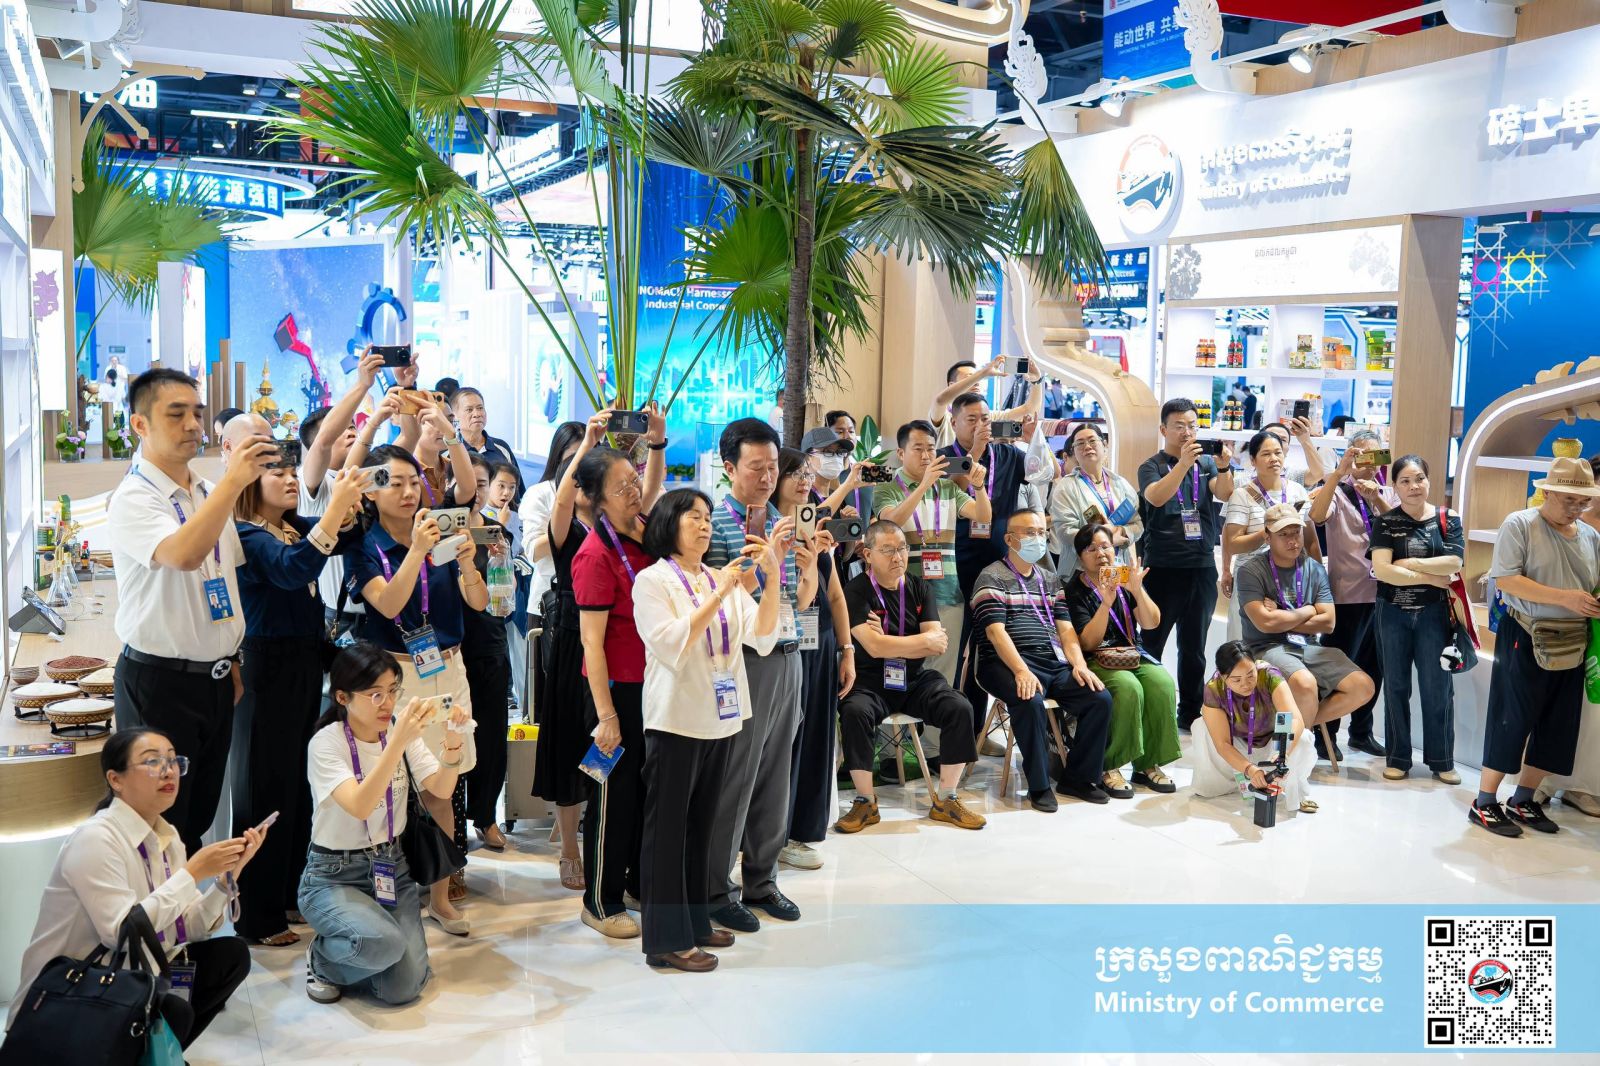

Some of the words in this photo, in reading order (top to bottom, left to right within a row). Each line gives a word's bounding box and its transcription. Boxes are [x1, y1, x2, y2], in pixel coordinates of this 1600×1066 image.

[1114, 21, 1155, 48] 能动世界
[645, 299, 694, 311] Industial
